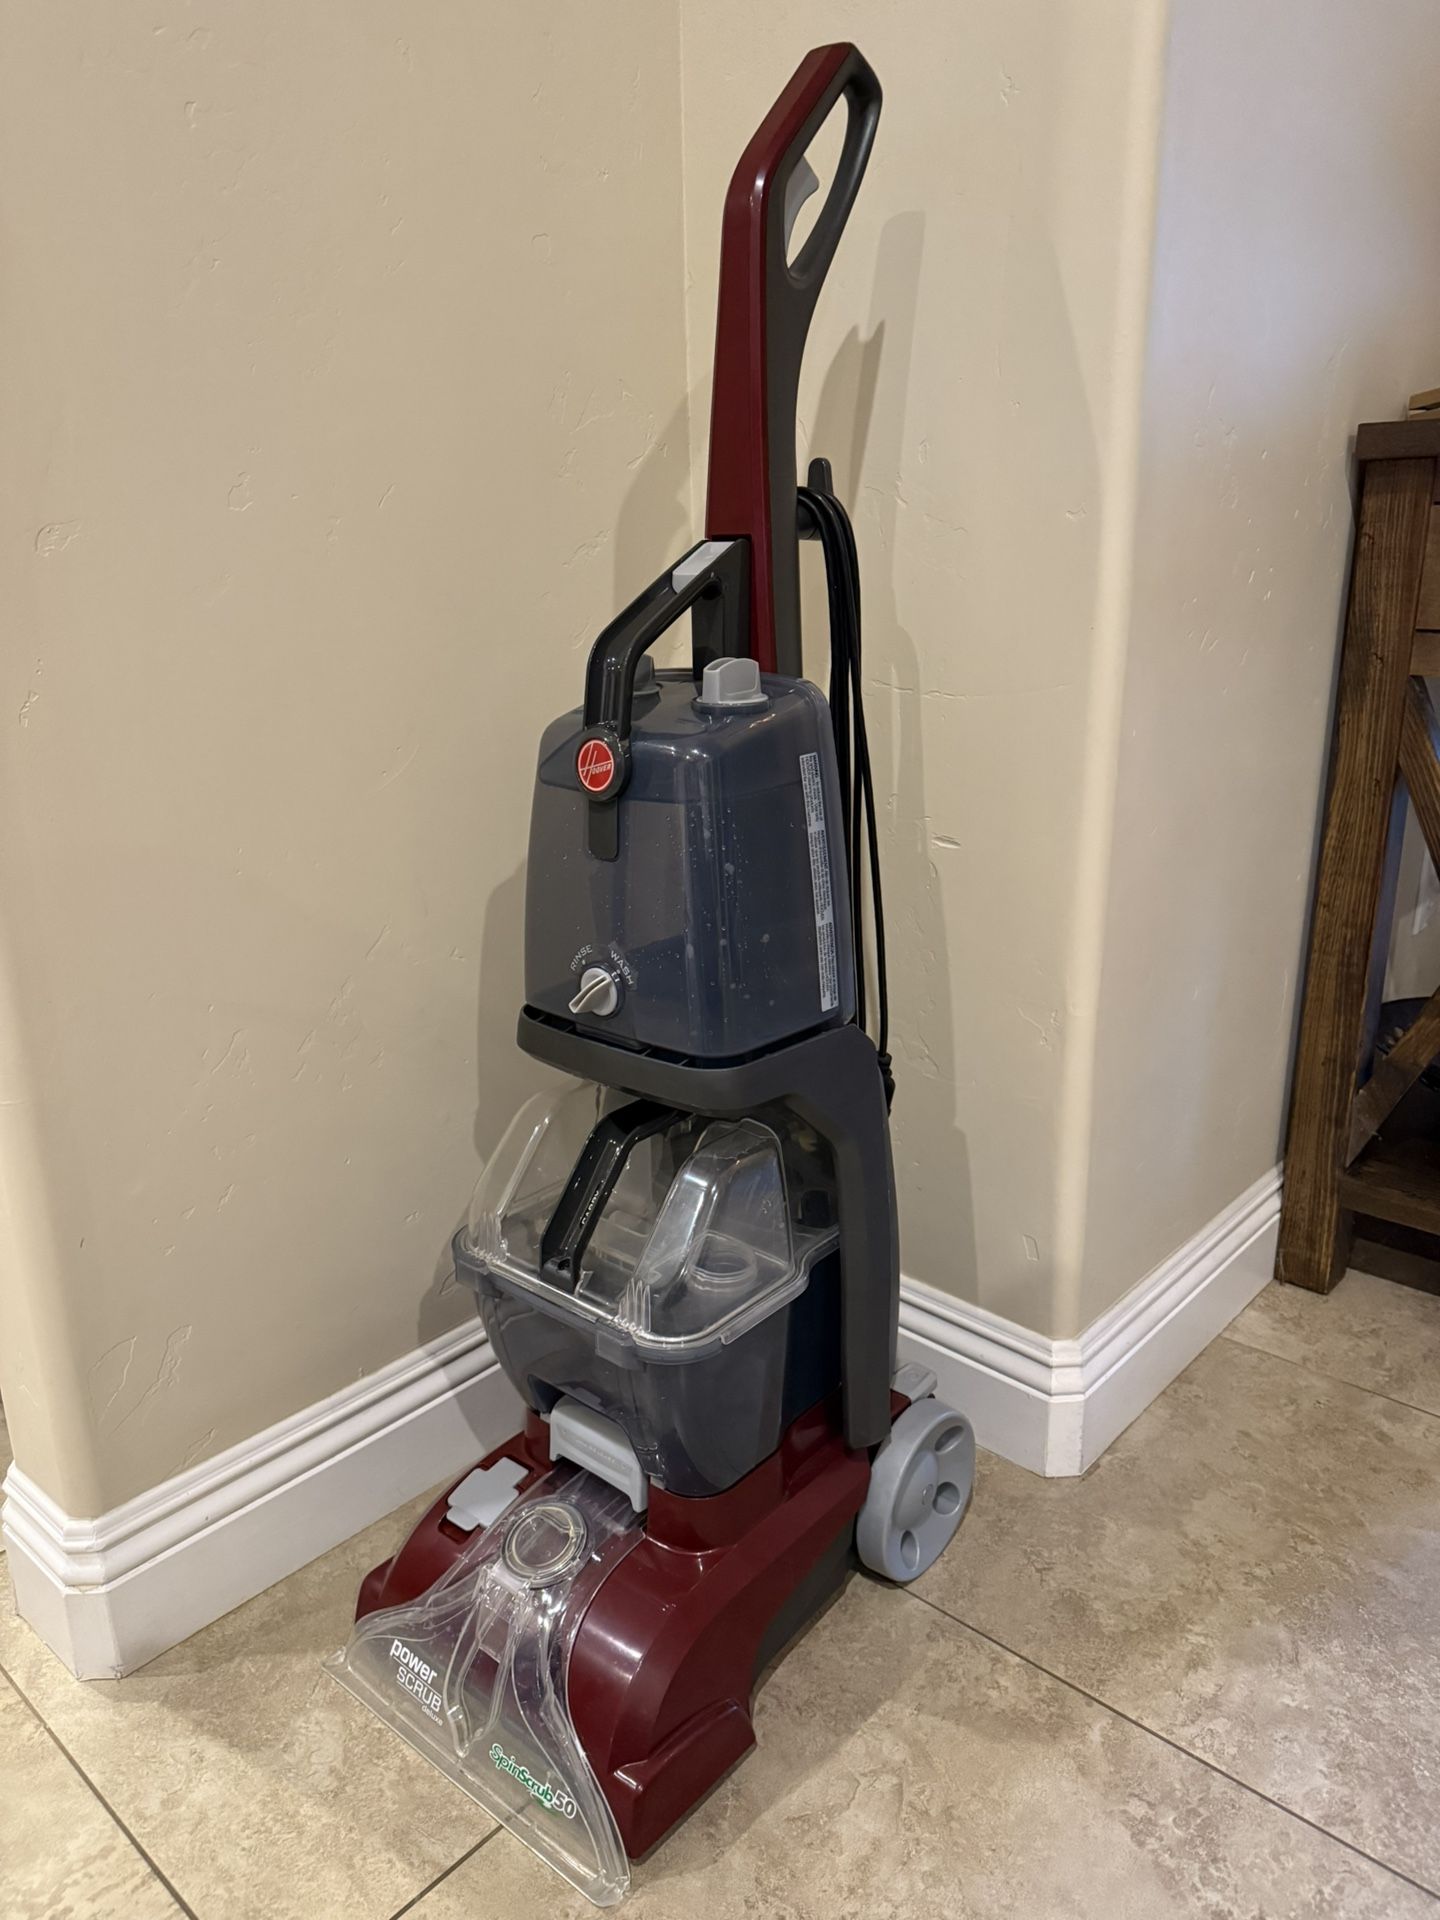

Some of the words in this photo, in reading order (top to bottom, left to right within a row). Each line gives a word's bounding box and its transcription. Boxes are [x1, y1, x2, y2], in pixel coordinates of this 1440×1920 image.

[570, 944, 593, 971] RINSE
[610, 950, 634, 985] WASH
[390, 1639, 438, 1684] power
[396, 1666, 442, 1712] SCRUB
[421, 1705, 443, 1727] deluxe
